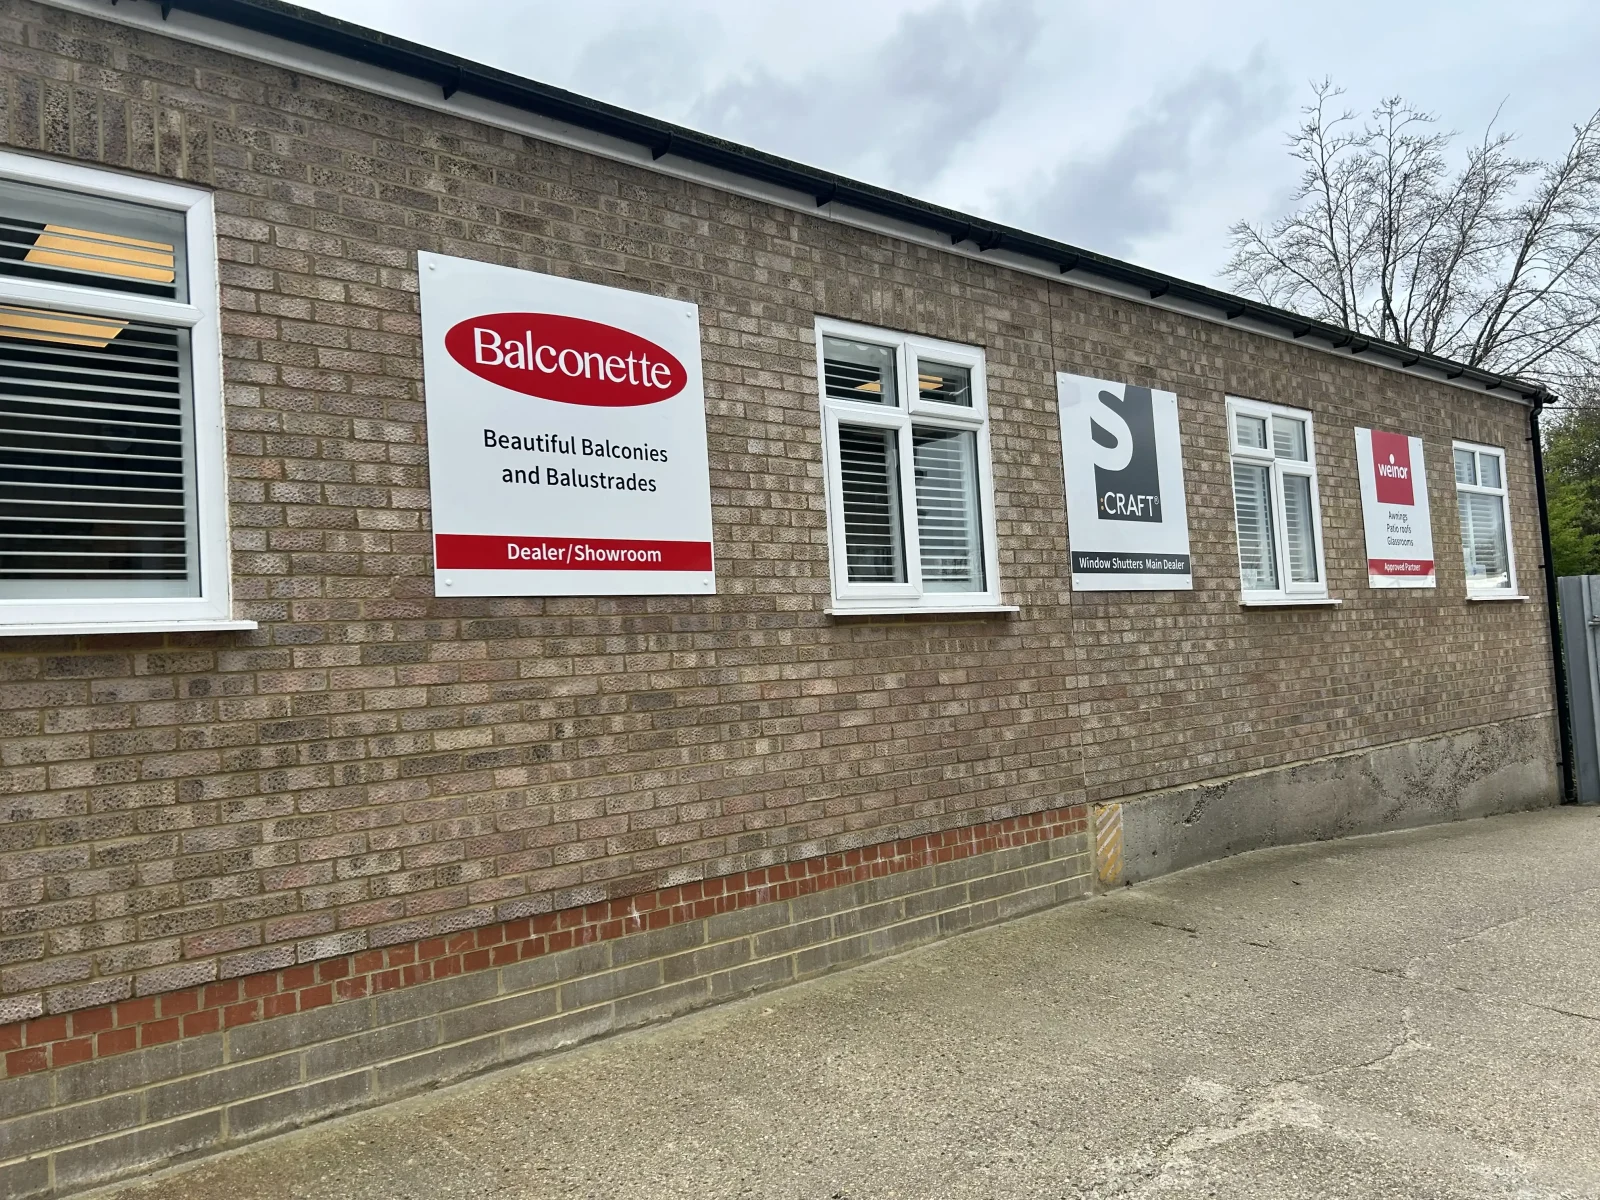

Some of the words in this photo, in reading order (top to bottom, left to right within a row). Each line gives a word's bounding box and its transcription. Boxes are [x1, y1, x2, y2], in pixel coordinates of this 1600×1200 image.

[473, 327, 673, 390] Balconette
[483, 428, 577, 456] Beautiful
[582, 438, 668, 463] Balconies
[1378, 453, 1408, 479] weinor
[501, 466, 541, 485] and
[546, 467, 657, 492] Balustrades
[1388, 511, 1408, 523] Awnings
[1386, 523, 1399, 533] Patio
[1399, 524, 1412, 534] roofs
[1387, 536, 1414, 547] Glassrooms
[507, 542, 662, 565] Dealer/Showroom
[1079, 557, 1110, 569] Window
[1112, 557, 1144, 570] Shutters
[1145, 558, 1163, 570] Main
[1163, 559, 1185, 570] Dealer
[1384, 562, 1405, 573] Approved
[1405, 562, 1421, 572] Partner
